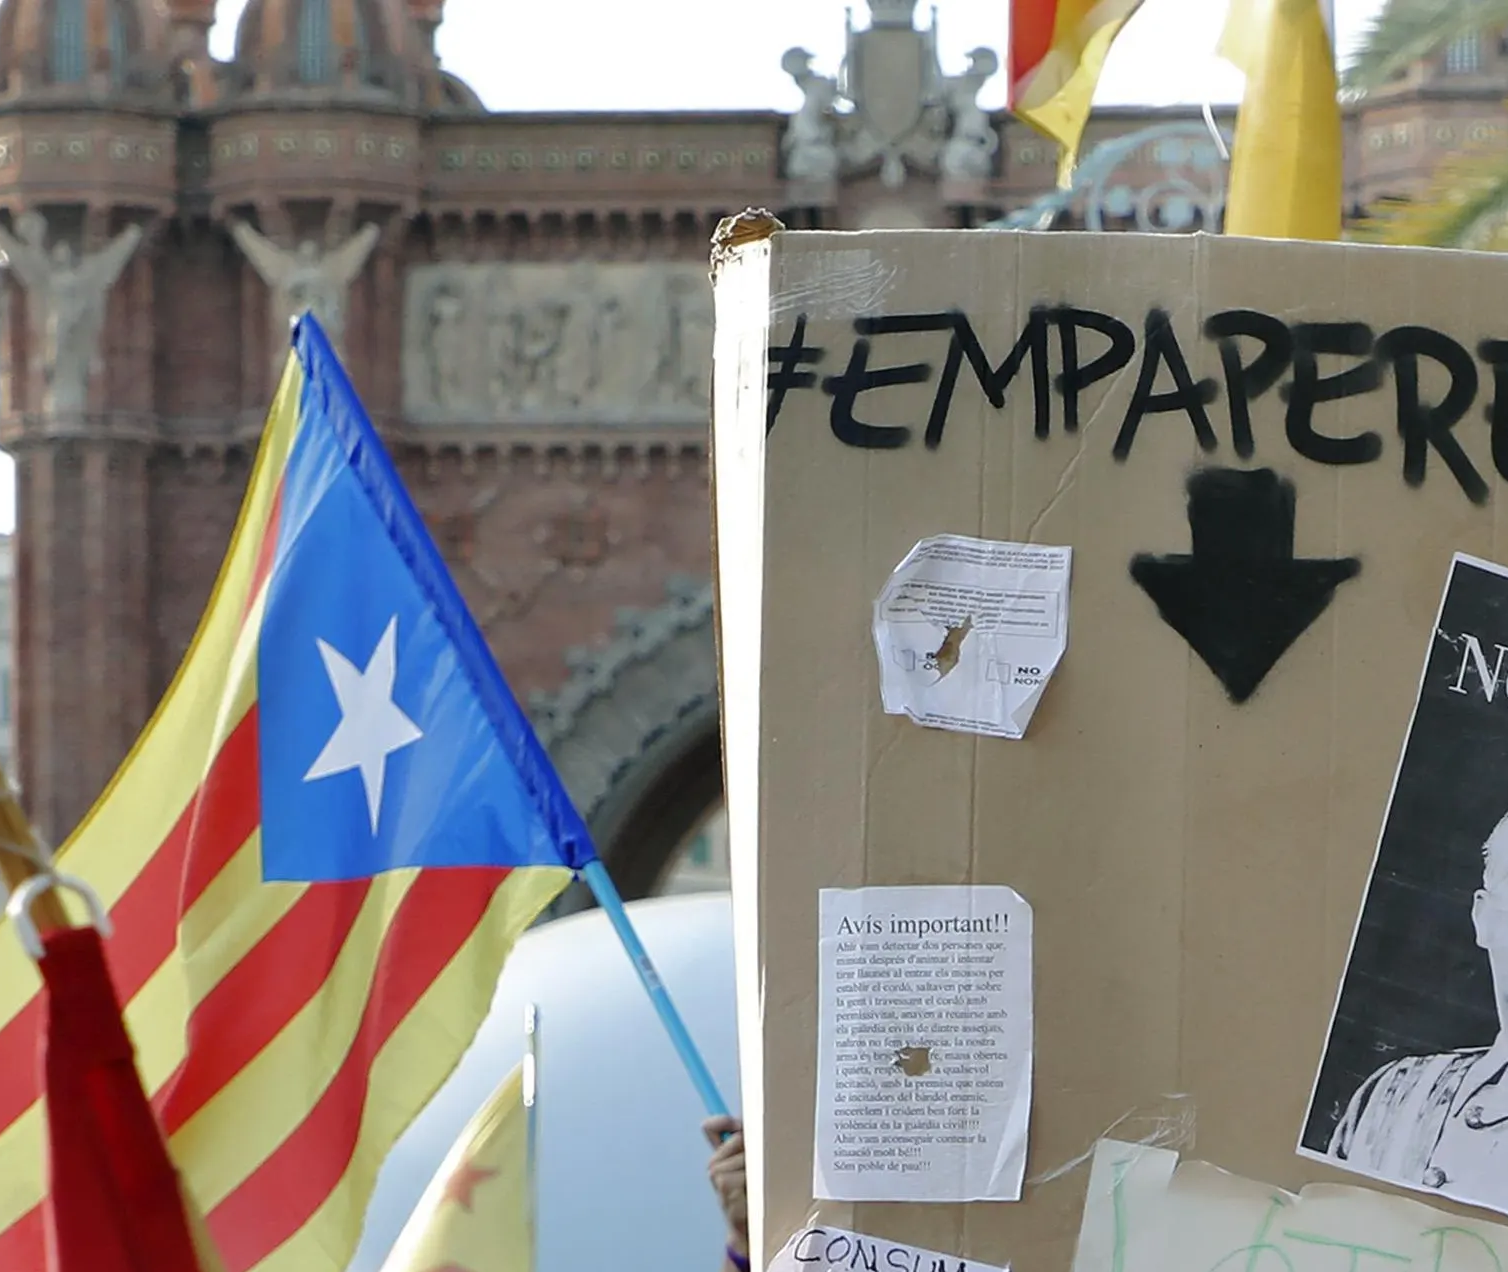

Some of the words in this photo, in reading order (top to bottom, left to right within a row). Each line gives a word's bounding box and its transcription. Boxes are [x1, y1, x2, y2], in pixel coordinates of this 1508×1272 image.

[1017, 666, 1041, 676] NO
[837, 914, 882, 935] Avís
[890, 913, 1008, 938] important!!
[922, 941, 939, 950] dos
[989, 970, 1004, 979] per
